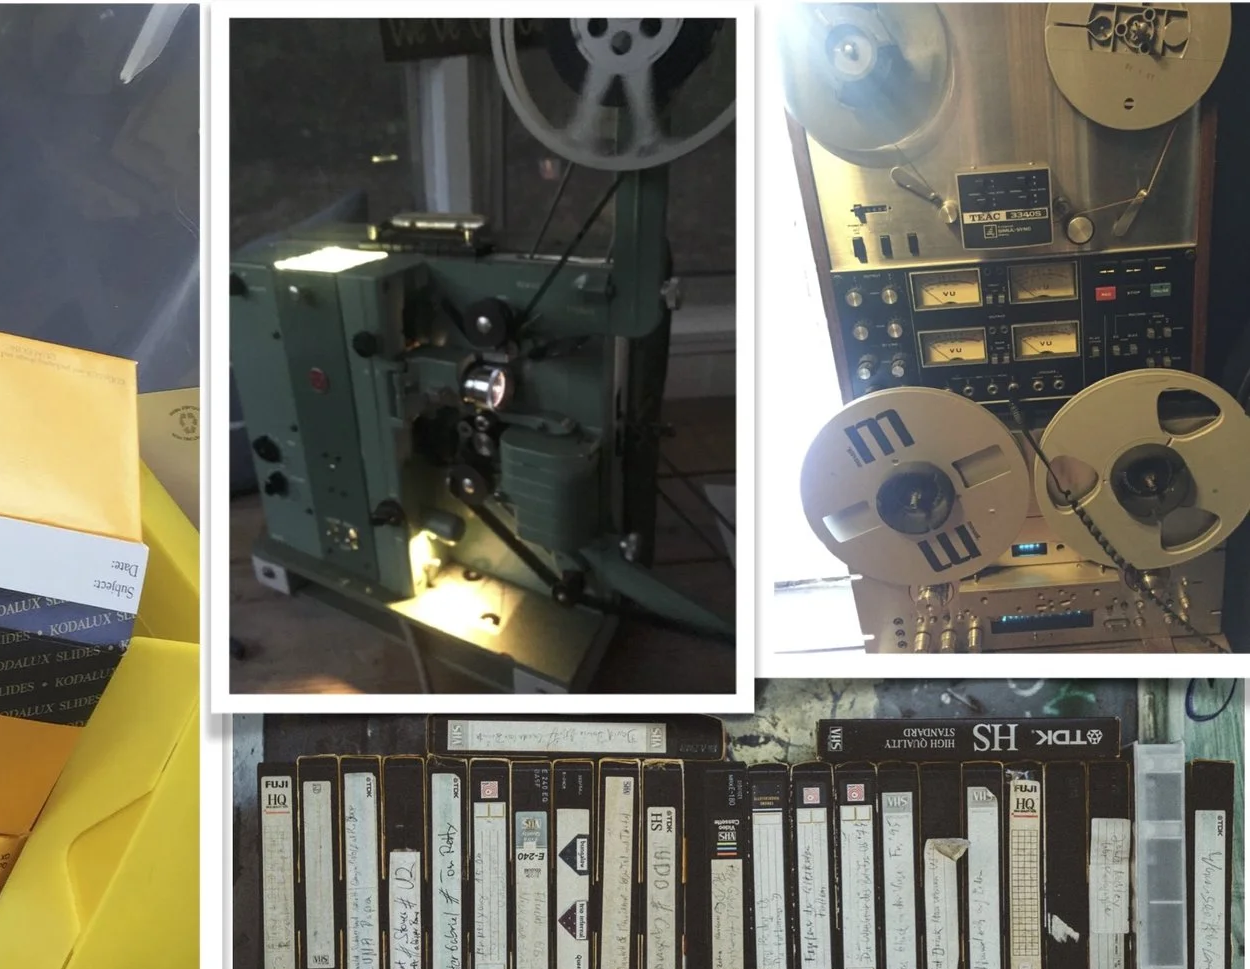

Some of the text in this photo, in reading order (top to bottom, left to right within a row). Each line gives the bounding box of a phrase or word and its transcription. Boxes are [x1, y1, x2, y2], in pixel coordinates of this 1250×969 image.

[969, 213, 1000, 222] TEAC
[111, 560, 139, 578] Date:
[94, 579, 135, 599] Subject:
[50, 613, 111, 637] KODALUX
[56, 646, 100, 662] SLIDES
[452, 725, 463, 745] VHS
[651, 729, 662, 749] VHS
[830, 727, 842, 750] VHS
[903, 728, 955, 737] STANDARD
[973, 724, 1019, 751] HS
[885, 739, 955, 749] HIGH QUALITY
[265, 780, 288, 788] FUJI
[268, 793, 287, 806] HQ
[1016, 798, 1035, 810] HQ
[651, 813, 662, 831] HS
[718, 832, 736, 841] VHS
[518, 852, 545, 860] E-240
[443, 912, 461, 952] Gabriel
